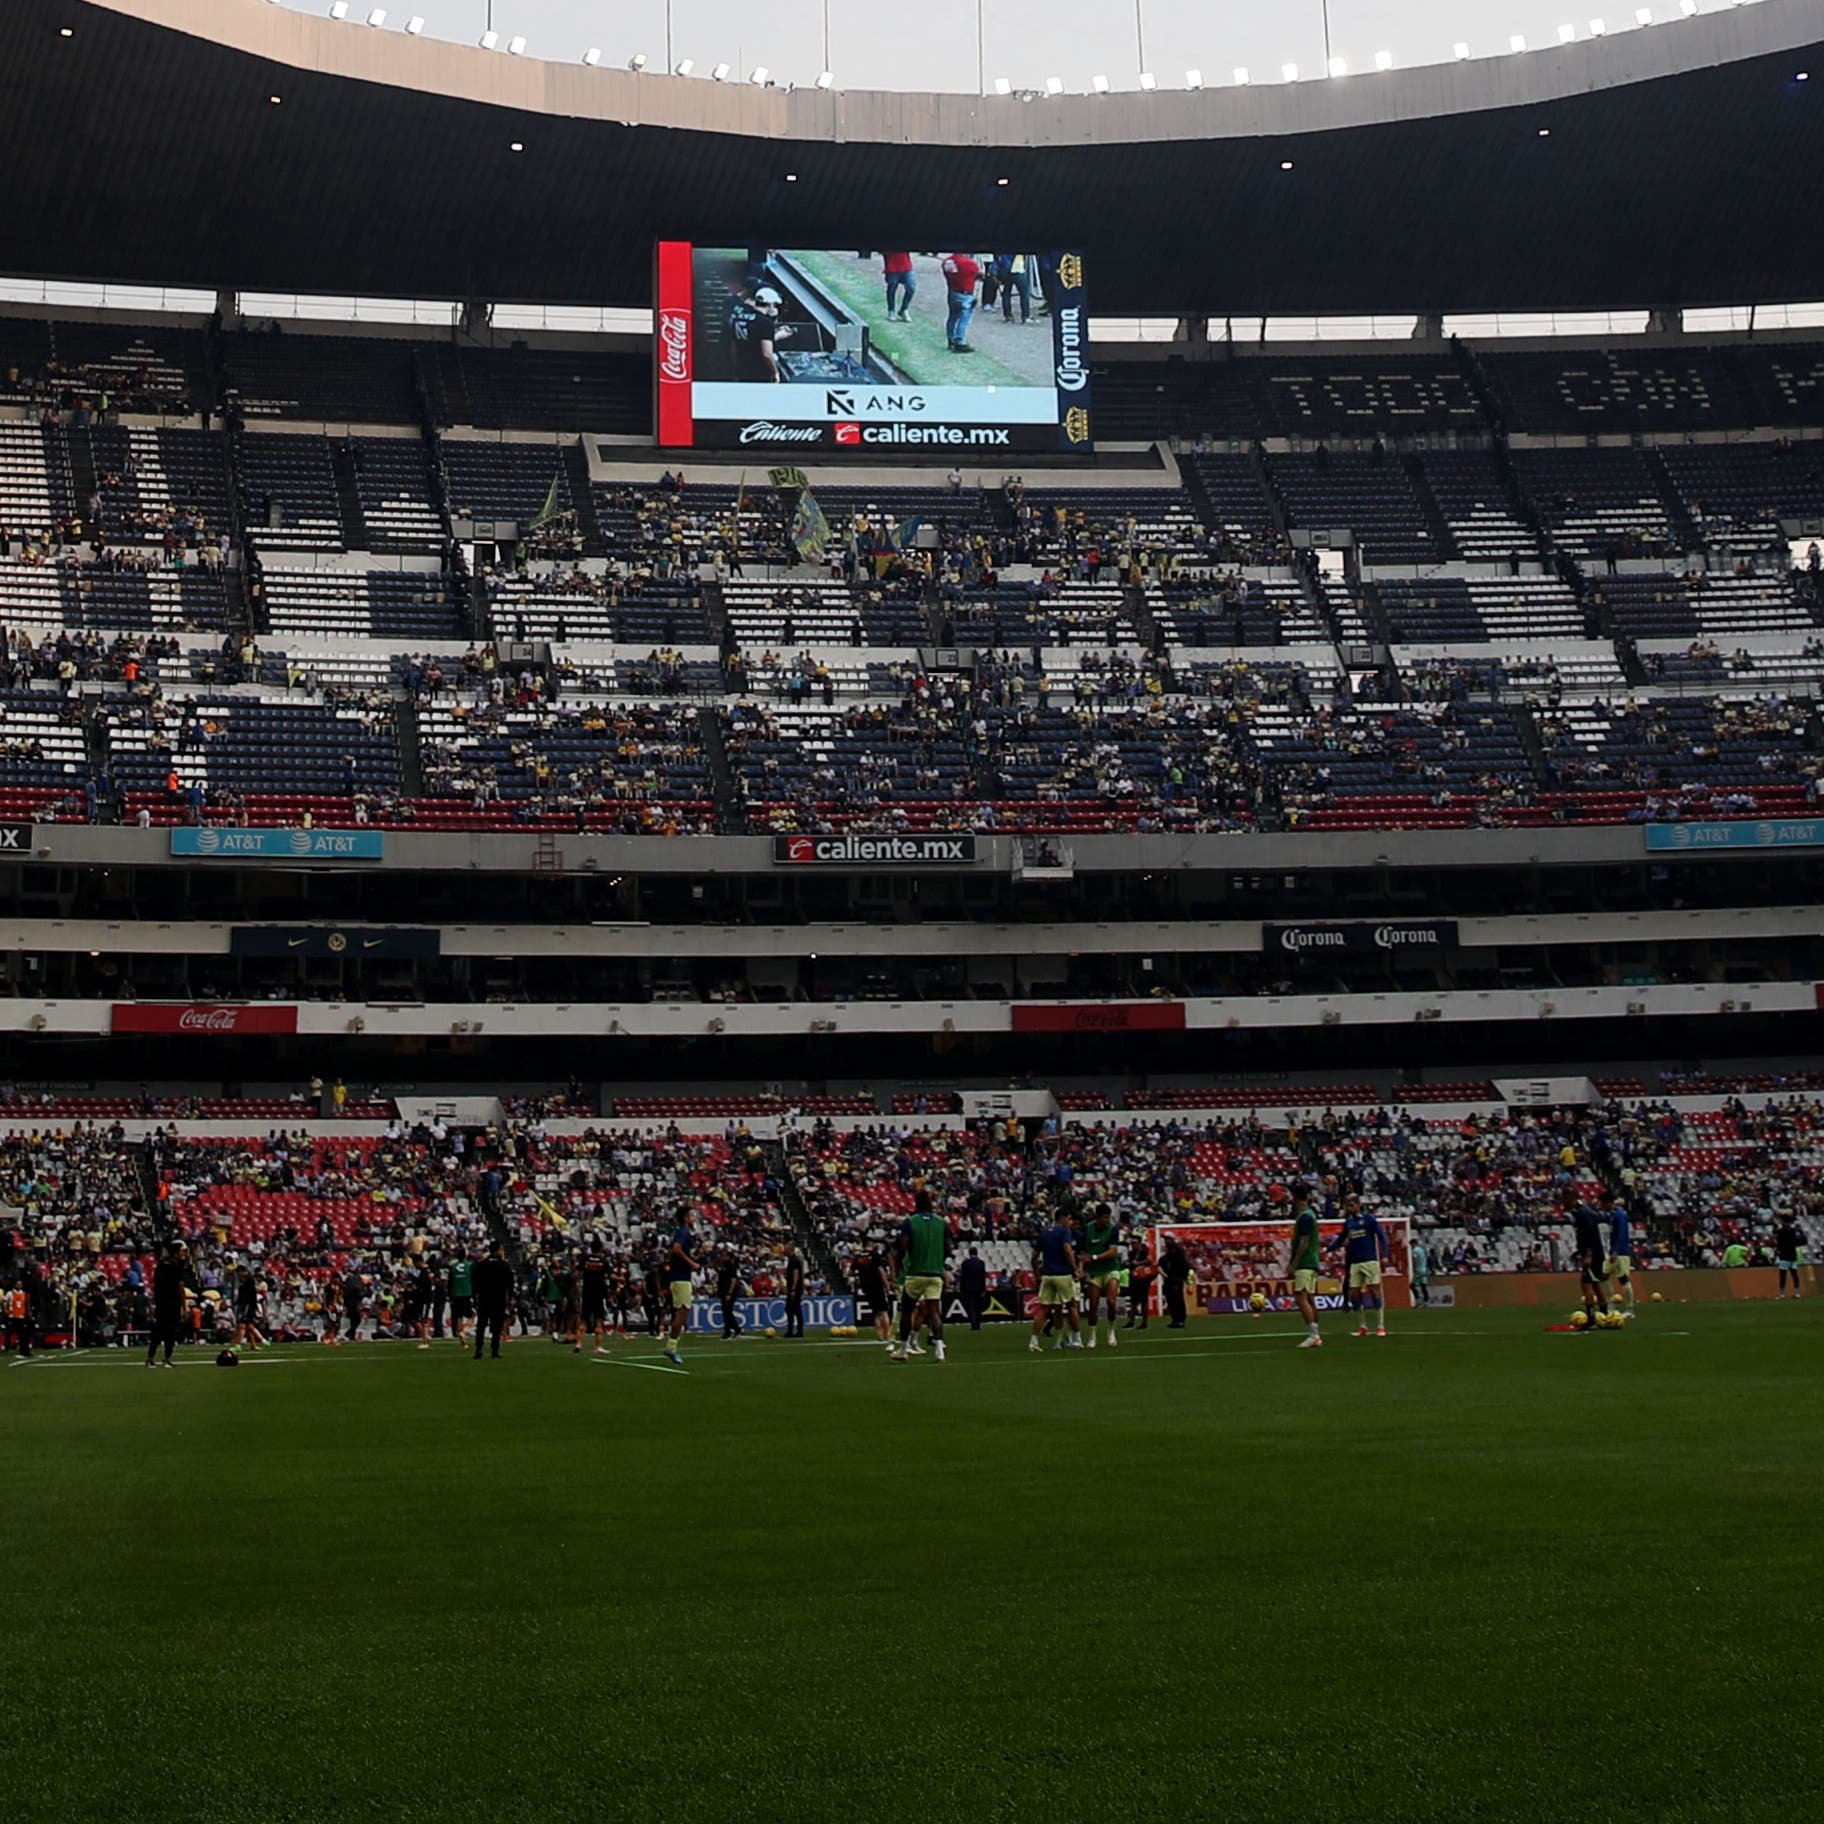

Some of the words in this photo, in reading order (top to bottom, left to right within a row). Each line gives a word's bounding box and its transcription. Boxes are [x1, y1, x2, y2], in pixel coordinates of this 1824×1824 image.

[1057, 308, 1090, 392] Corona
[862, 424, 1010, 446] caliente.mx
[223, 834, 264, 851] AT&T
[315, 835, 356, 852] AT&T
[1694, 827, 1732, 843] AT&T
[1778, 824, 1816, 840] AT&T
[816, 836, 963, 862] caliente.mx
[1281, 928, 1345, 952] Corona
[1374, 926, 1438, 949] Corona
[1232, 1297, 1274, 1313] LIA
